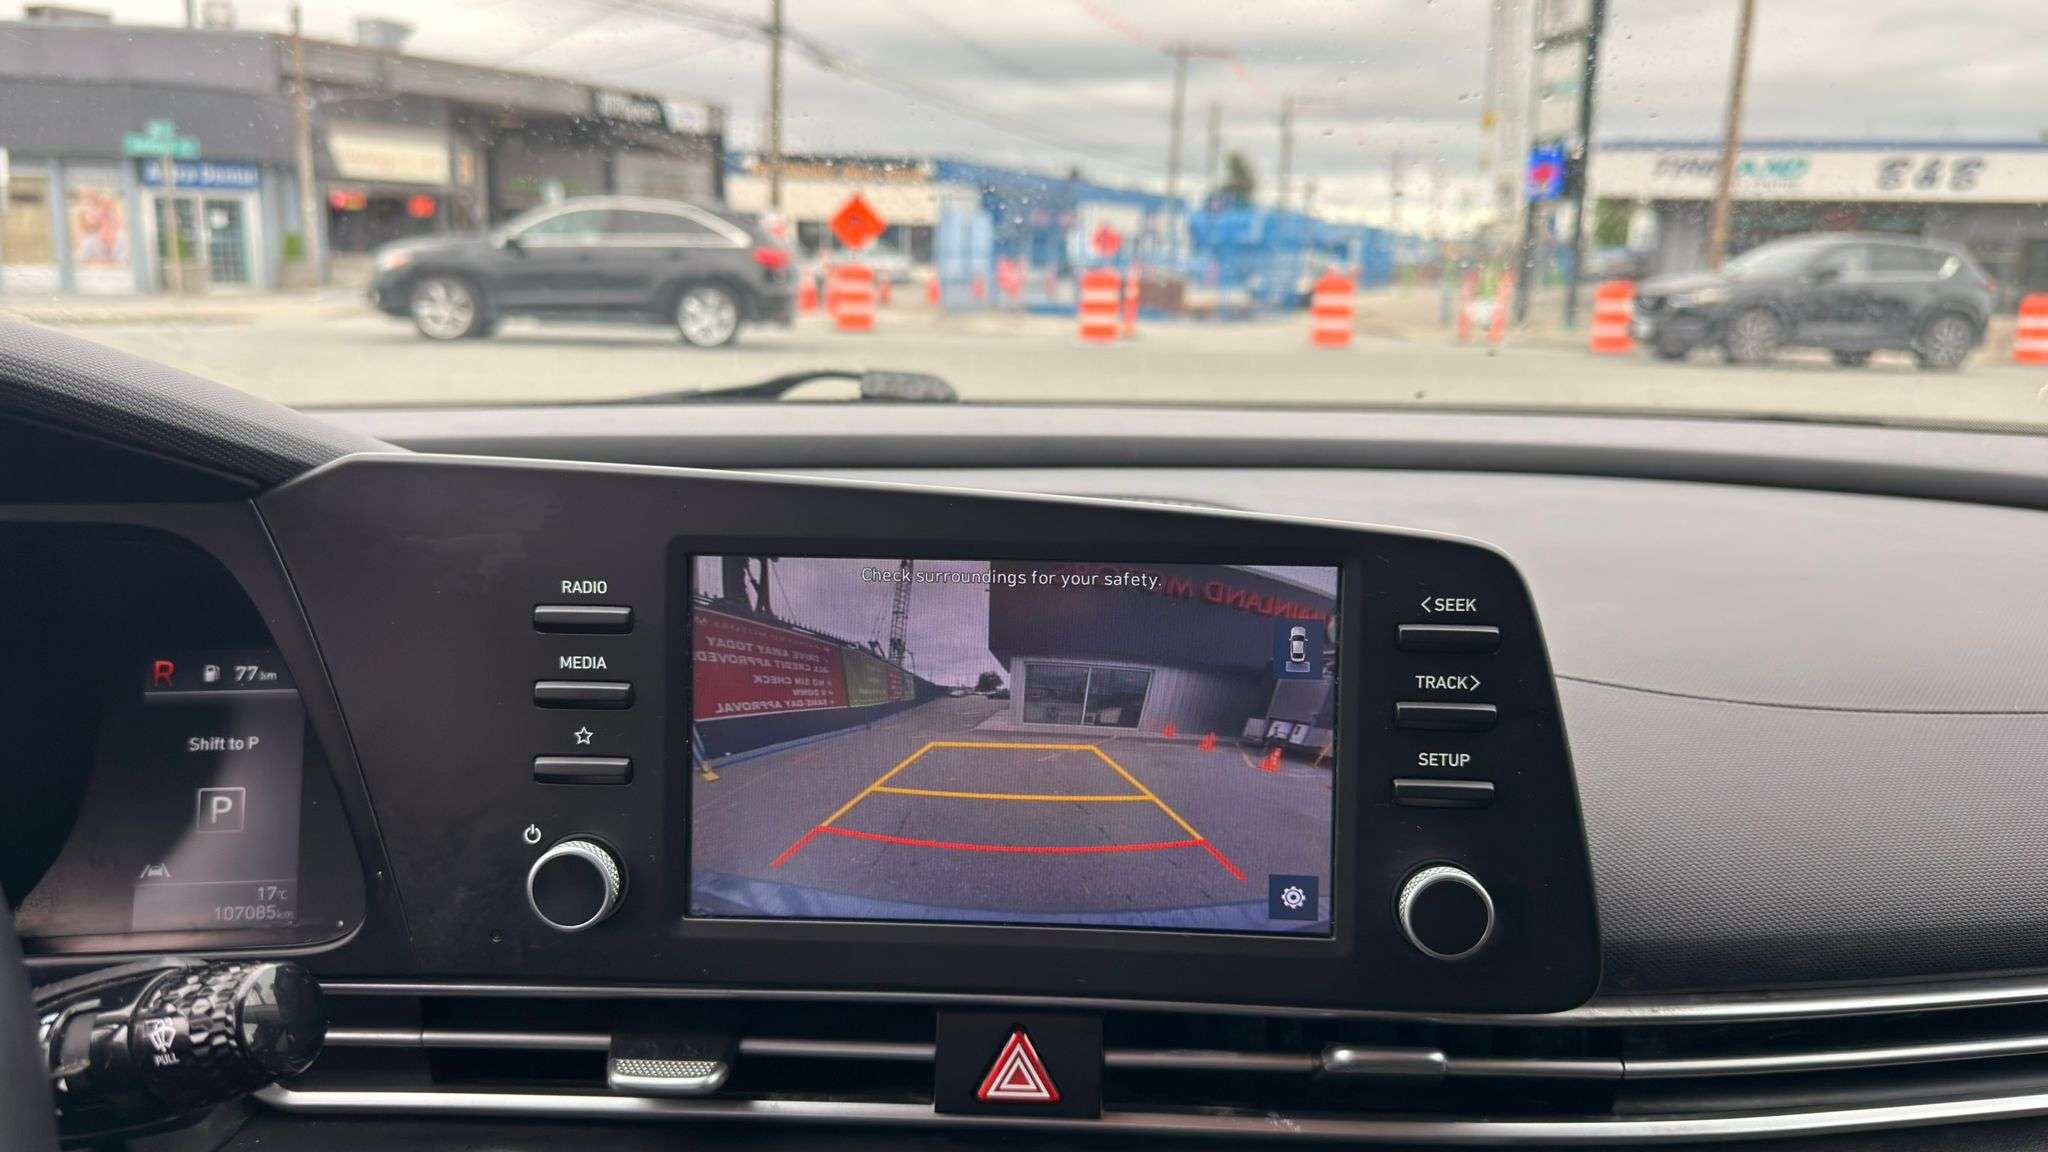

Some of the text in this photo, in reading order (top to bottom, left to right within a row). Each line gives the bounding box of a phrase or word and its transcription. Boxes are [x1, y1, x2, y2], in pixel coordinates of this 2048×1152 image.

[861, 567, 912, 583] Check
[915, 568, 1026, 587] surroundings
[1030, 570, 1056, 585] for
[1060, 574, 1099, 588] your
[1103, 571, 1162, 590] safety.
[561, 580, 608, 594] RADIO
[560, 656, 608, 670] MEDIA
[154, 660, 176, 686] R
[189, 736, 260, 752] Shift to P
[1418, 753, 1471, 767] SETUP
[212, 796, 233, 824] P
[154, 1053, 180, 1067] PULL
